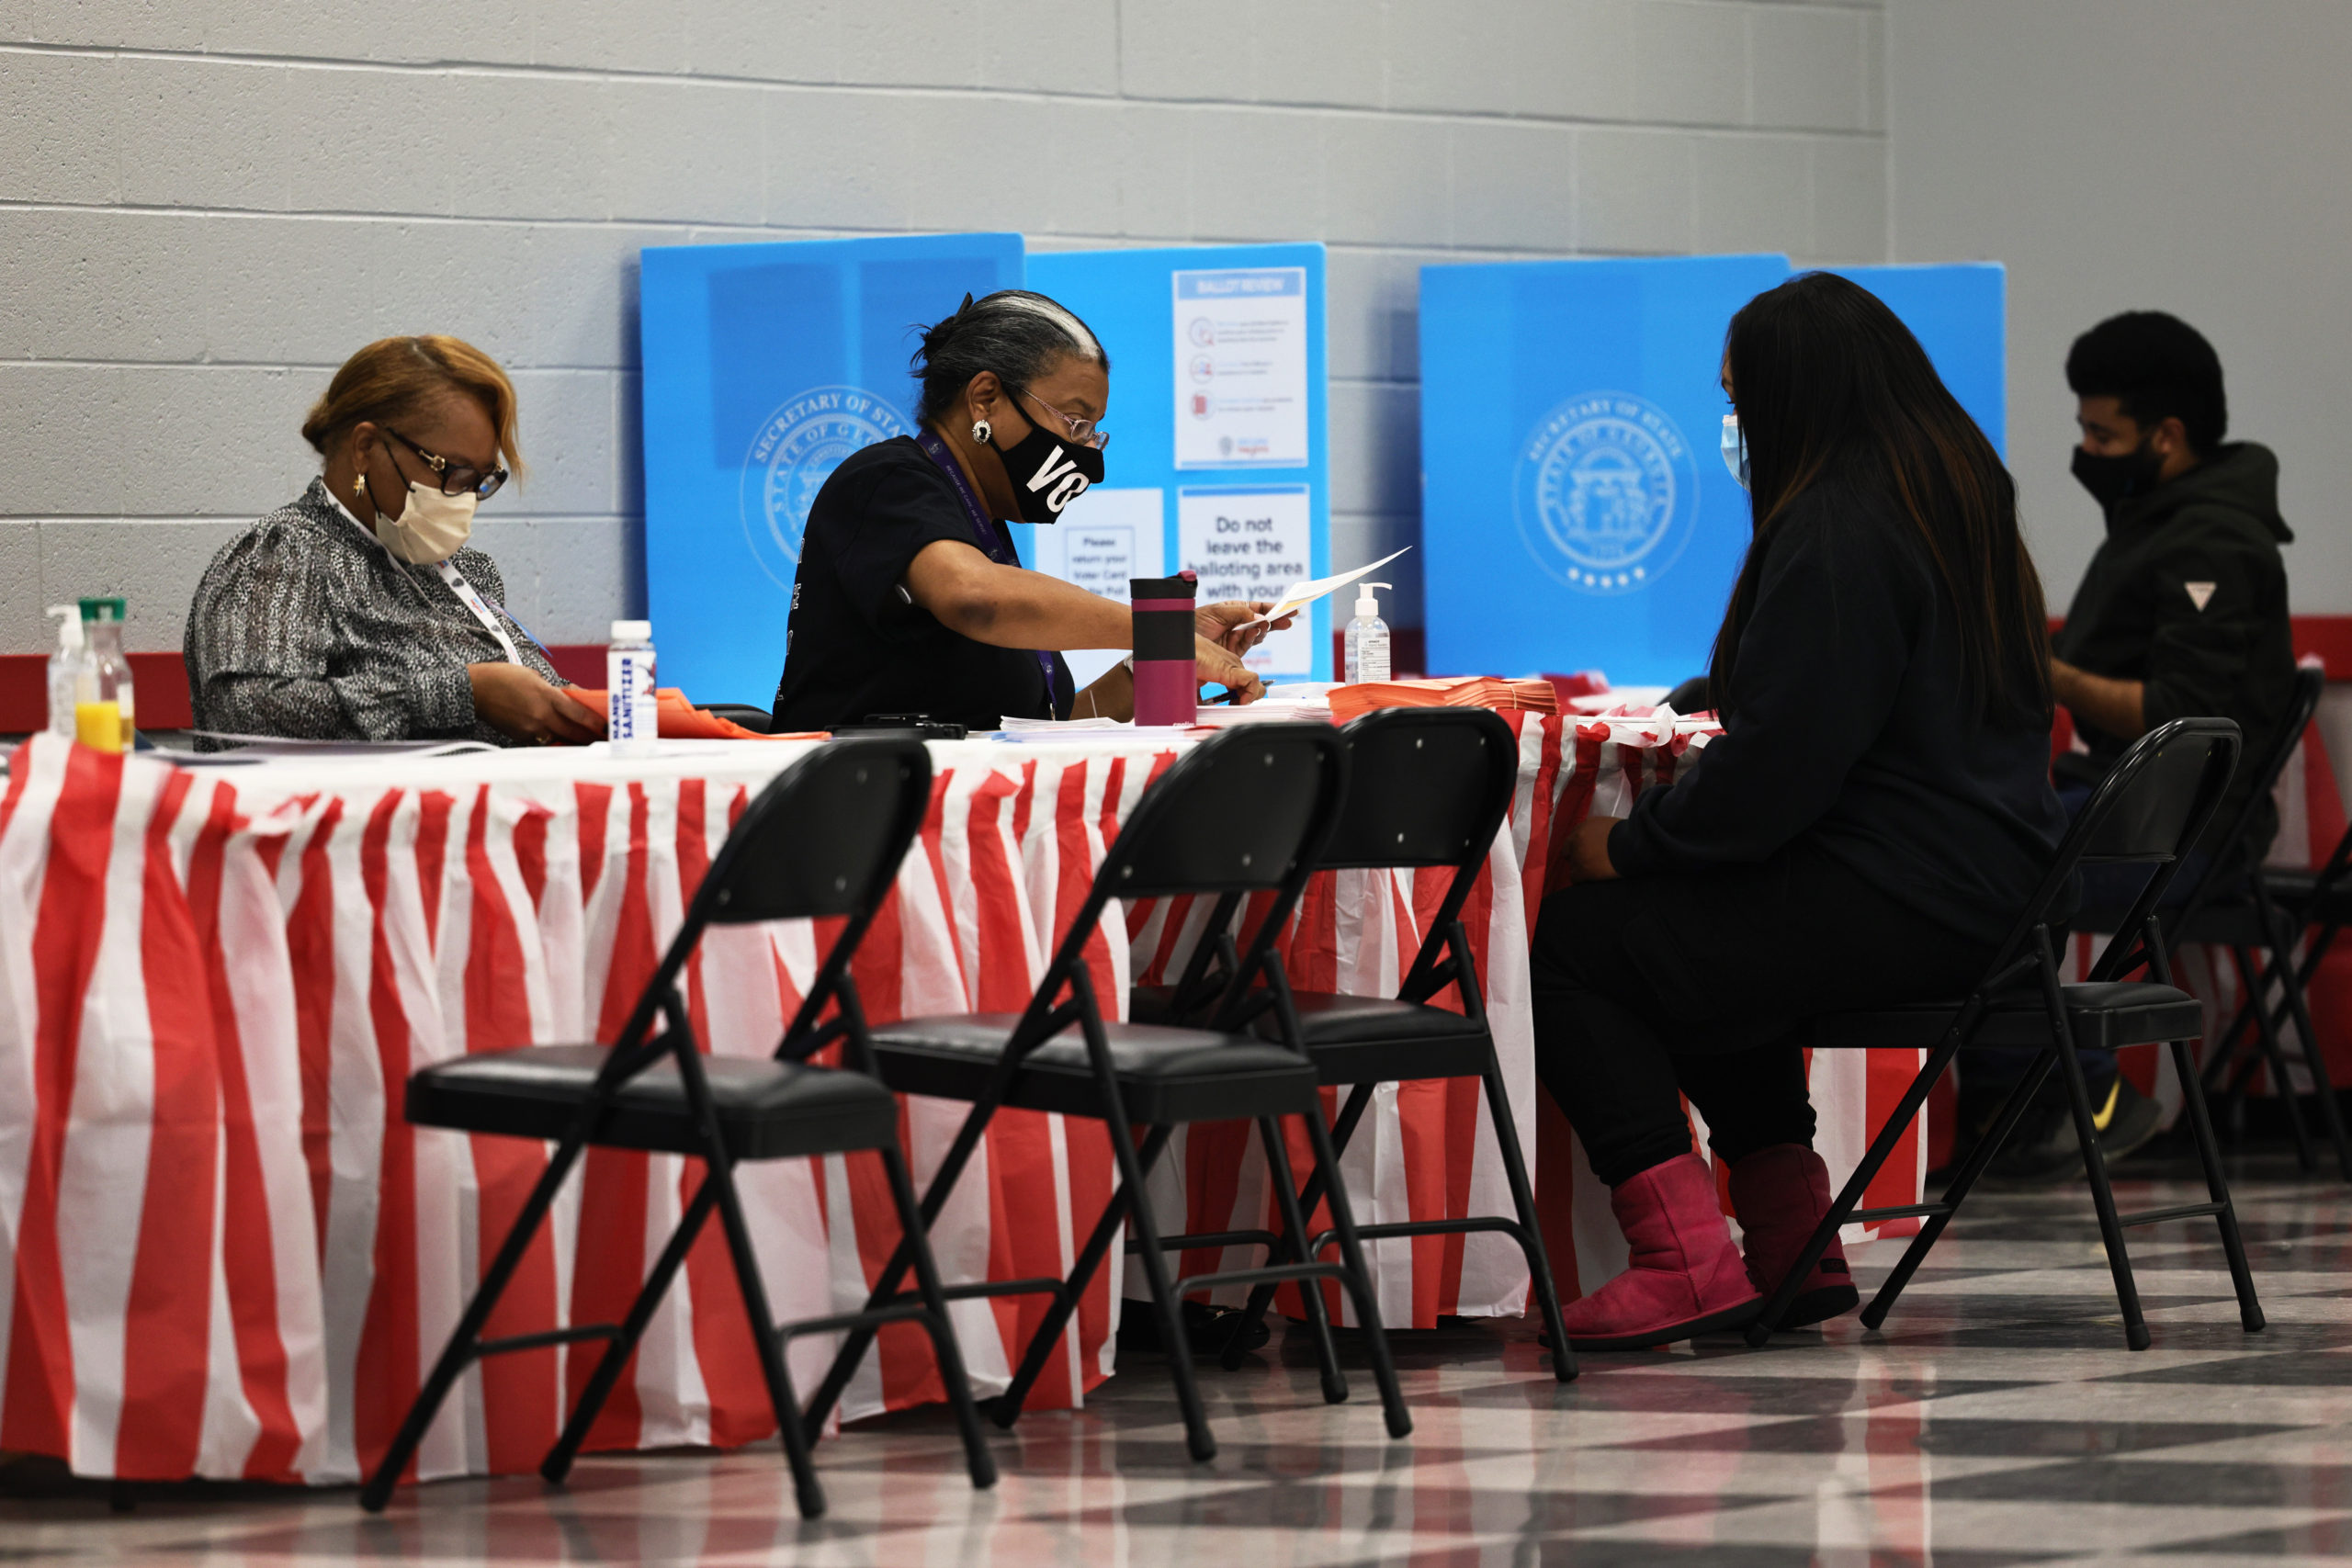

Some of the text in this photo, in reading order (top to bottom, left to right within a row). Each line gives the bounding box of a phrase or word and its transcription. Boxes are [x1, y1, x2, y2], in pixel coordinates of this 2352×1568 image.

[755, 393, 841, 463] SECRETARY
[845, 395, 871, 412] OF
[871, 407, 907, 439] STA
[1530, 400, 1682, 459] SECRETARY OF STATE
[773, 441, 804, 513] STATE
[805, 424, 827, 442] OF
[1206, 539, 1283, 555] leave the
[1216, 516, 1272, 533] Do not
[1266, 562, 1304, 576] area
[1206, 582, 1284, 603] with your
[611, 694, 620, 740] HAND
[621, 657, 633, 739] SANITIZER
